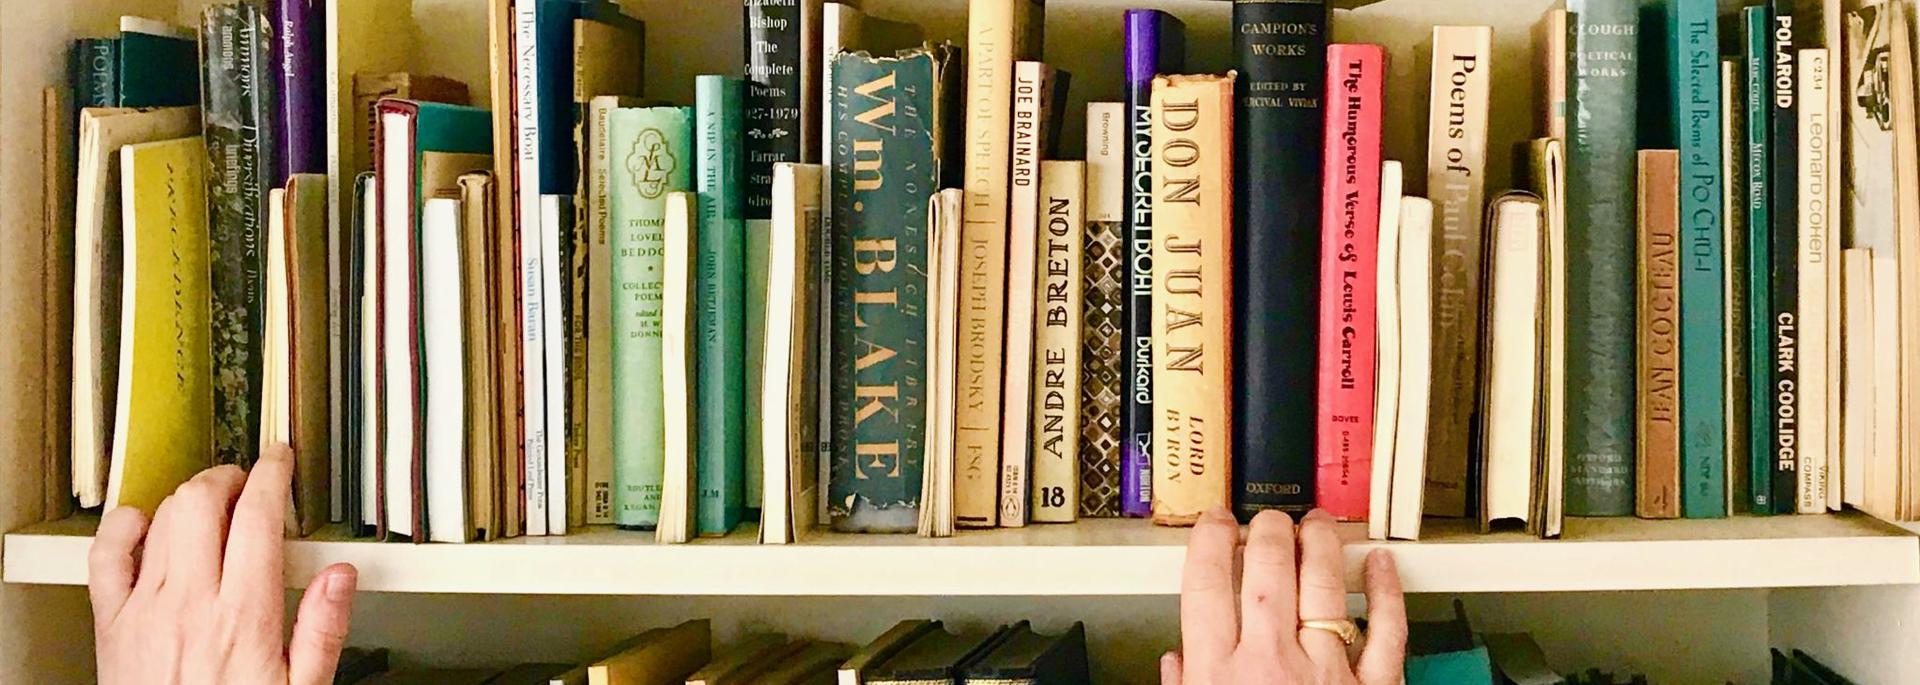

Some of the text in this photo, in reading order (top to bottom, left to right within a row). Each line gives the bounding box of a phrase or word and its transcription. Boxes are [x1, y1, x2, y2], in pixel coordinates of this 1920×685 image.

[281, 20, 294, 48] Ralph
[750, 16, 788, 31] Bishop
[757, 41, 779, 53] The
[1690, 19, 1709, 45] The
[239, 18, 257, 97] Ammons
[743, 62, 794, 77] Complete
[979, 41, 994, 88] PART
[1251, 44, 1306, 56] WORKS
[1775, 15, 1793, 109] POLAROID
[93, 46, 110, 107] POEMS
[519, 10, 537, 161] The Necessary Boat
[750, 85, 787, 98] Poems
[1292, 83, 1307, 91] BY
[1448, 54, 1477, 139] Poems
[1690, 50, 1709, 104] Selected
[222, 26, 242, 194] ammons briefings
[837, 84, 849, 121] HIS
[903, 84, 917, 139] THE
[978, 97, 993, 120] OF
[706, 123, 717, 144] NIP
[1014, 77, 1033, 187] JOE BRAINARD
[1100, 111, 1111, 156] Browning
[1691, 109, 1709, 148] Poems
[597, 107, 608, 245] Baudelaire Selected Poems
[706, 147, 717, 162] IN
[706, 166, 717, 191] THE
[750, 150, 786, 162] Farrar
[974, 130, 992, 208] SPEECH
[1446, 147, 1471, 178] of
[1691, 153, 1711, 167] of
[706, 196, 717, 219] AIR
[1443, 183, 1470, 241] Paul
[1692, 174, 1714, 203] PO
[1752, 181, 1763, 210] ROAD
[1161, 98, 1203, 376] DON JUAN
[1339, 59, 1363, 390] The Humorous Verse of Lewis Carroll
[526, 257, 539, 342] Susan Baran
[705, 250, 717, 342] JOHN BETJEMAN
[853, 70, 899, 480] Wm. BLAKE
[1043, 196, 1070, 460] ANDRE BRETON
[1650, 231, 1674, 423] JEAN COCTEAU
[966, 239, 989, 481] JOSEPH BRODSKY FSG
[1136, 336, 1152, 405] Burkard
[1777, 311, 1795, 473] CLARK COOLIDGE
[1165, 408, 1181, 485] BYRON
[1188, 415, 1205, 477] LORD
[1041, 486, 1066, 509] 18
[1139, 468, 1151, 502] NORTON
[1246, 482, 1301, 494] OXFORD
[1802, 456, 1812, 508] COMPASS
